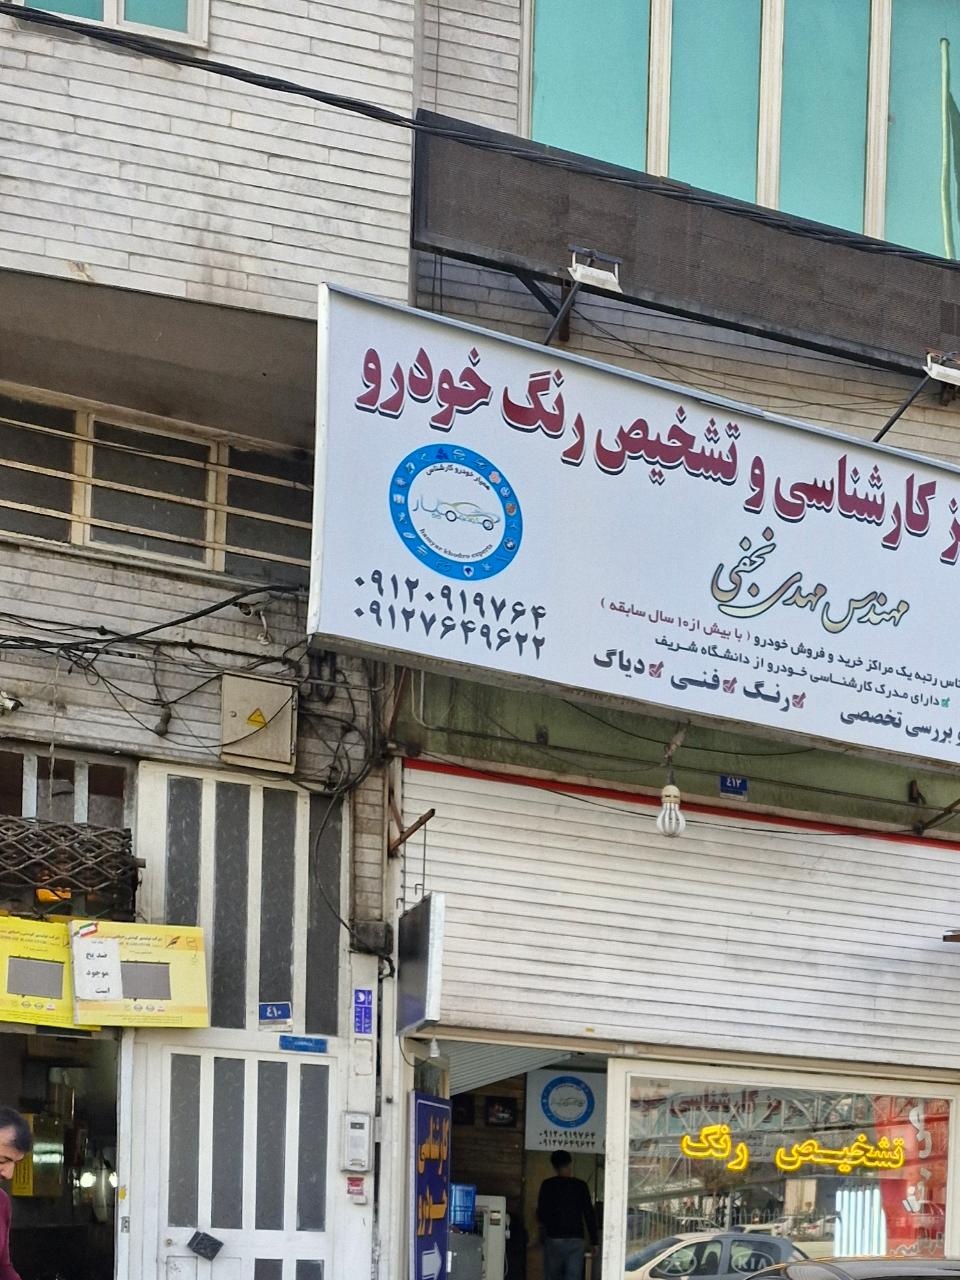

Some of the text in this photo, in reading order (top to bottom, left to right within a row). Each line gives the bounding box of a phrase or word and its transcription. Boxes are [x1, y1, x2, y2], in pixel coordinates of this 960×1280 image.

[354, 347, 495, 432] خودرو
[502, 368, 585, 466] رنگ
[594, 405, 742, 485] تشخیص
[743, 455, 766, 513] و
[773, 454, 937, 551] کارشناسی
[354, 569, 547, 630] ۰۹۱۲۰۹۱۹۷۶۴
[717, 571, 828, 619] مهدی
[609, 600, 646, 618] سابقه
[648, 609, 674, 624] سال
[821, 590, 909, 633] مهندس
[353, 600, 546, 660] ۰۹۱۲۷۶۴۹۶۲۲
[703, 622, 731, 641] بیش
[733, 626, 743, 641] با
[753, 634, 788, 651] خودرو
[791, 642, 825, 660] فروش
[593, 647, 646, 678] دیاگ
[827, 652, 834, 664] و
[837, 653, 863, 669] خرید
[866, 659, 893, 675] مراکز
[655, 634, 940, 708] دارای مدرک کارشناسی خودرو از دانشگاه شریف
[670, 667, 721, 691] فنی
[896, 666, 912, 681] یک
[915, 671, 938, 687] رتبه
[743, 681, 791, 713] رنگ
[840, 706, 902, 729] تخصصی
[904, 722, 953, 745] بررسی
[86, 969, 109, 978] موجود
[95, 986, 110, 994] است
[417, 1115, 450, 1175] کارشناسی
[680, 1123, 907, 1174] تشخیص رنگ
[416, 1176, 450, 1236] خودرو
[737, 1256, 768, 1270] KIA
